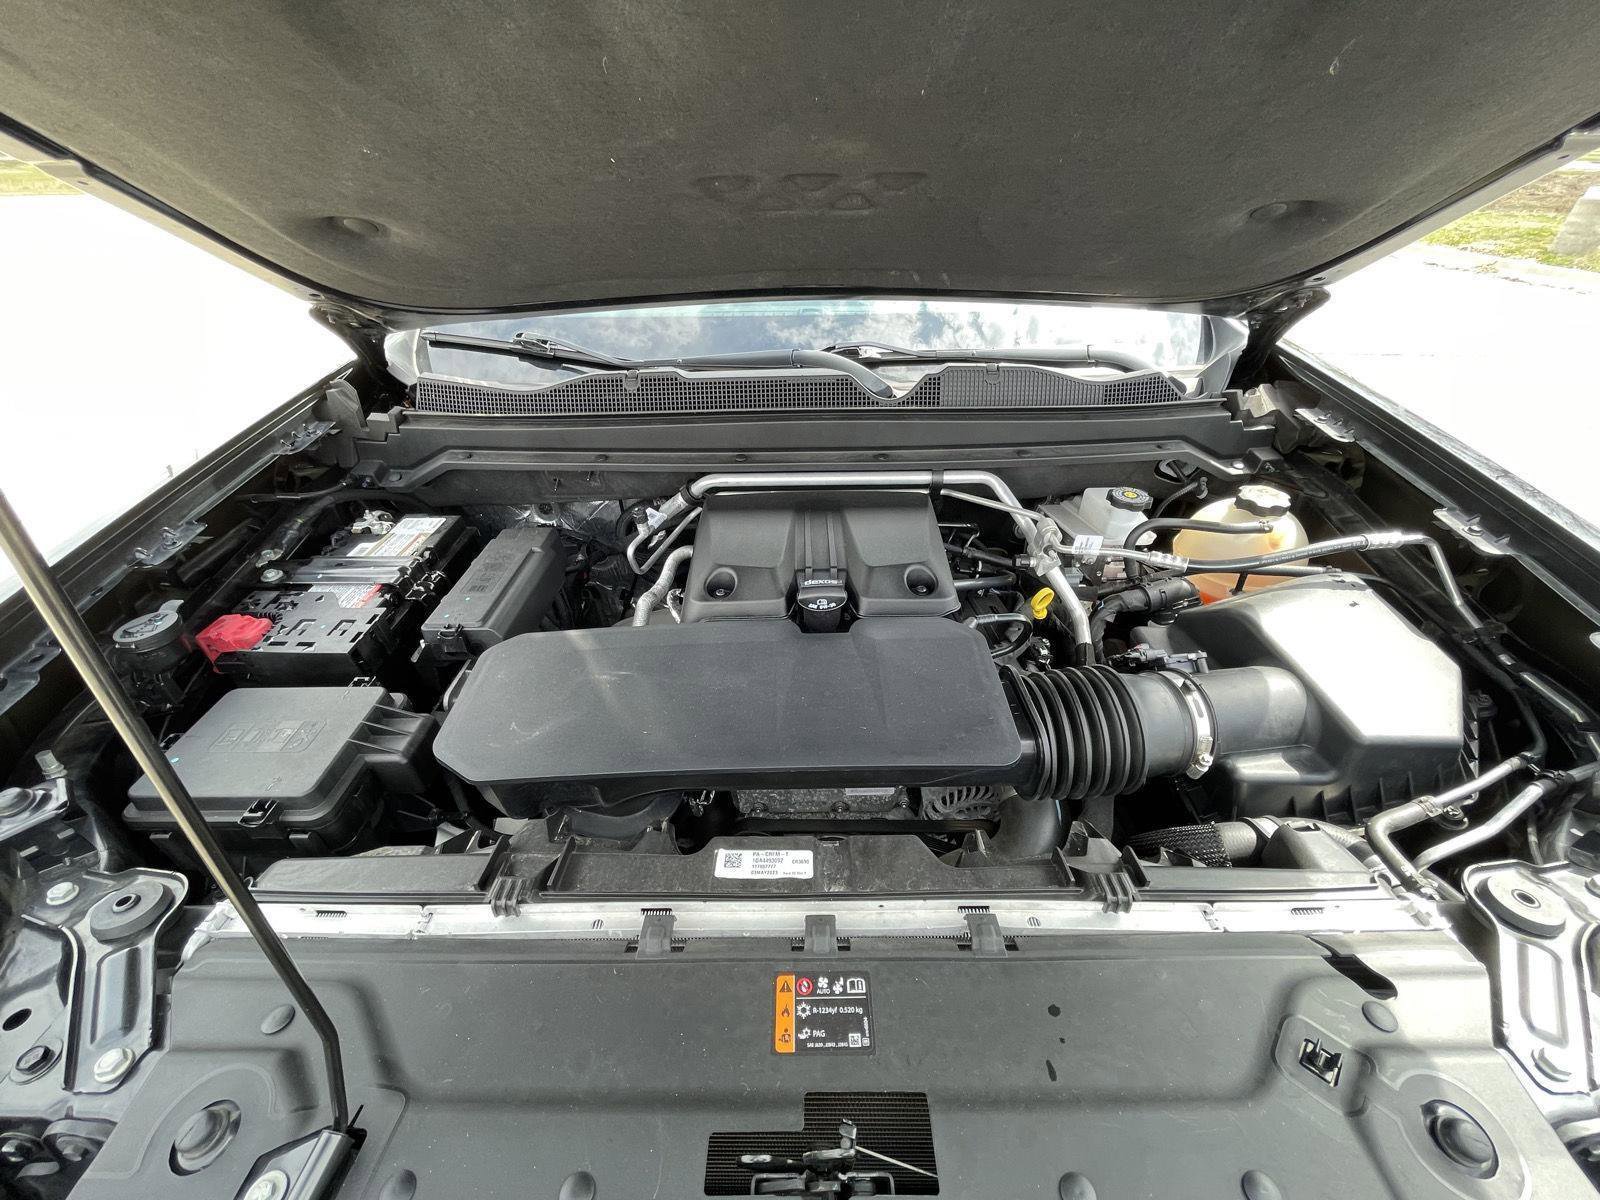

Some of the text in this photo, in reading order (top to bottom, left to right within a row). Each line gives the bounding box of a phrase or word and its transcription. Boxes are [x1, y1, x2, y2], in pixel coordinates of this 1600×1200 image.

[812, 1006, 838, 1015] R-1234yf
[855, 1006, 863, 1015] kg
[812, 1029, 826, 1038] PAG
